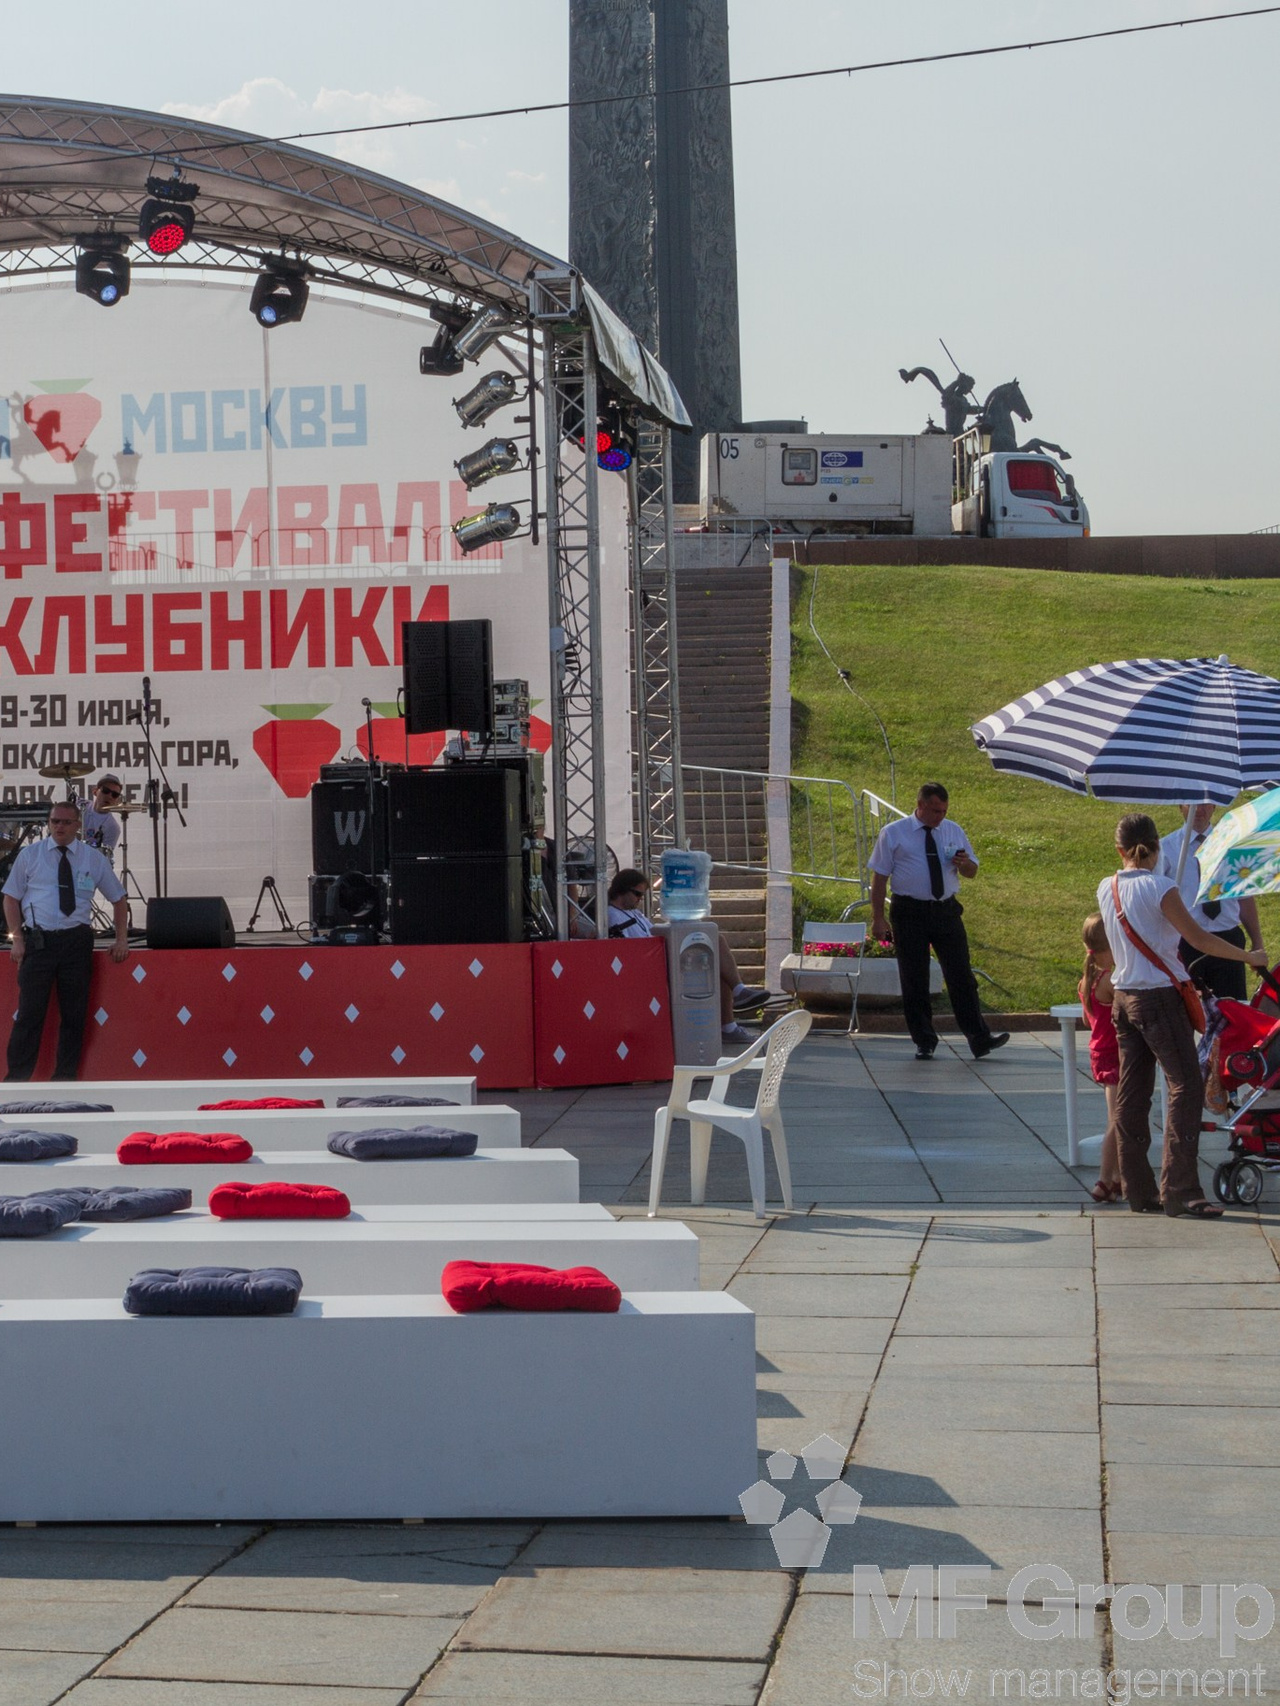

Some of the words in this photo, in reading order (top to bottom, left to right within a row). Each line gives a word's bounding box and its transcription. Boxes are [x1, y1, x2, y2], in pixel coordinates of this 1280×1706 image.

[120, 383, 368, 454] МОСКВУ
[720, 438, 740, 460] 05
[333, 810, 366, 846] W
